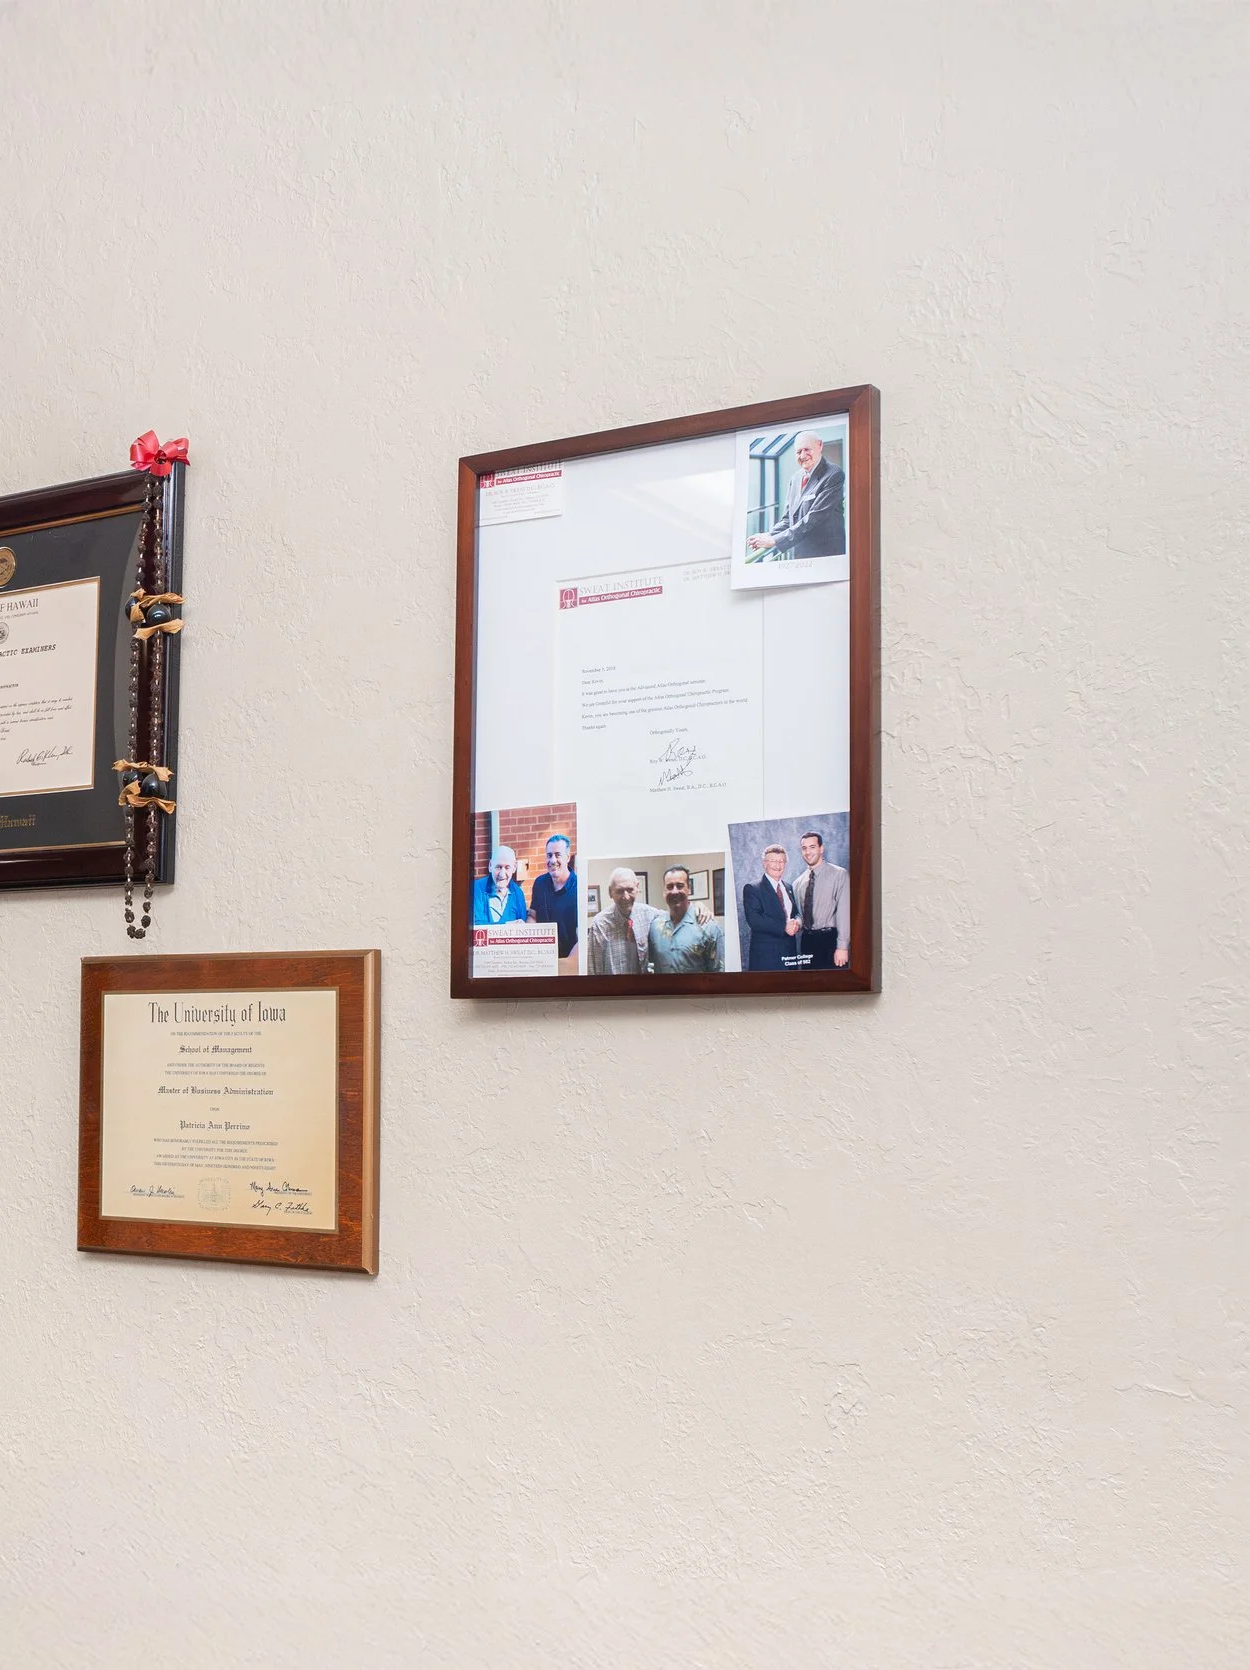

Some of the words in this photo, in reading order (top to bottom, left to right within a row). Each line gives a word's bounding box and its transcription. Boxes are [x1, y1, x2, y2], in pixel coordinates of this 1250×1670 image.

[579, 583, 609, 595] SWEAT
[613, 576, 663, 592] INSTITUTE
[588, 595, 600, 603] Atlas
[600, 592, 630, 601] Orthogonal
[630, 588, 660, 599] Chiropractic
[6, 598, 38, 611] HAWAII
[21, 644, 56, 654] EXAMINERS
[515, 928, 556, 936] INSTITUTE
[148, 1002, 169, 1023] The
[174, 1001, 236, 1027] University
[241, 1003, 253, 1022] of
[258, 1001, 286, 1022] Iowa
[179, 1045, 201, 1055] School
[203, 1045, 209, 1053] of
[211, 1045, 252, 1055] Management
[158, 1086, 180, 1095] Master
[182, 1086, 189, 1094] of
[190, 1086, 221, 1095] Business
[223, 1086, 274, 1096] Administration
[180, 1120, 205, 1130] Patricia
[207, 1121, 223, 1130] Ann
[224, 1121, 250, 1131] Perrino
